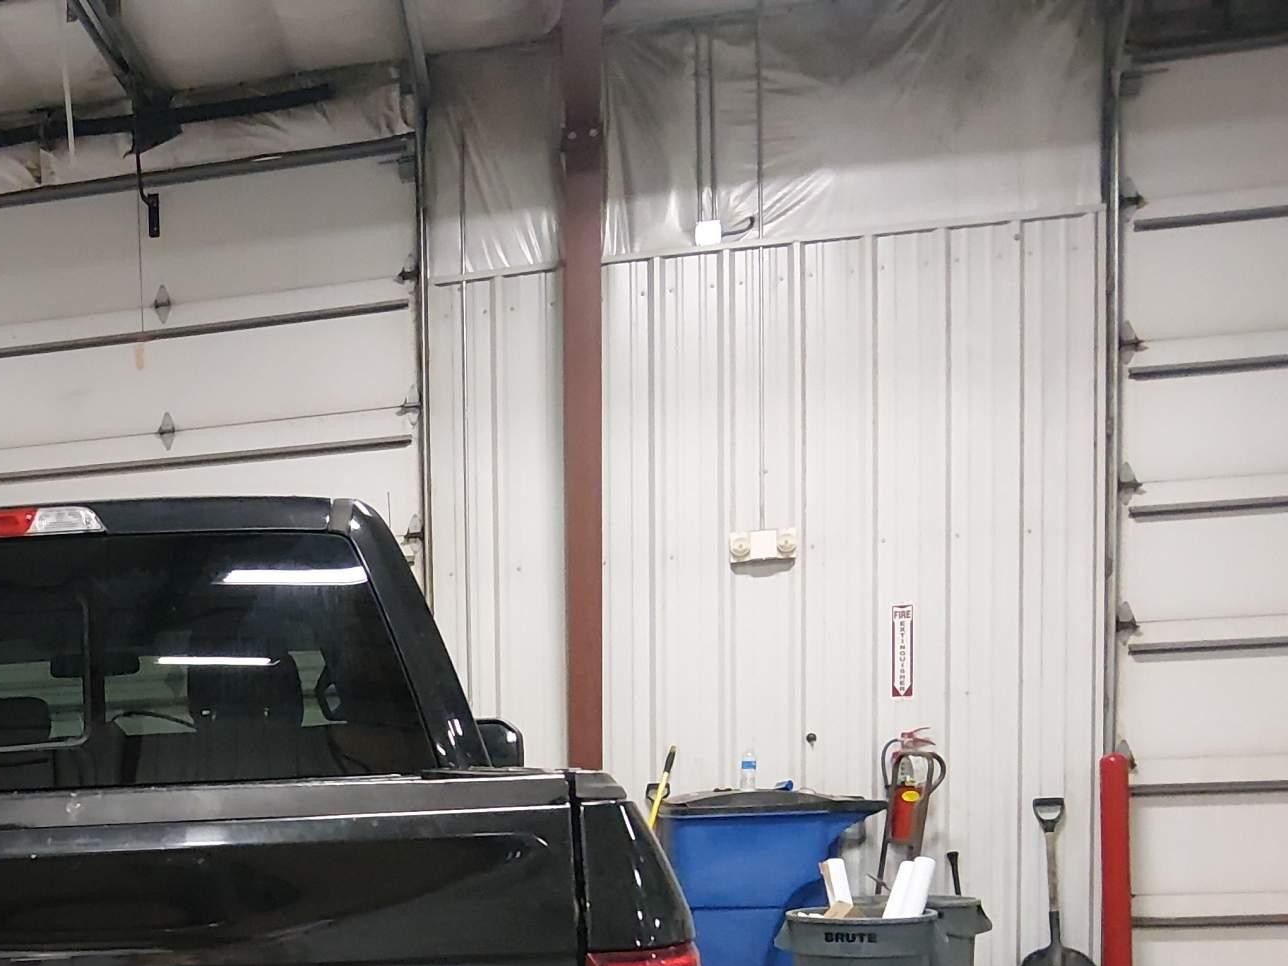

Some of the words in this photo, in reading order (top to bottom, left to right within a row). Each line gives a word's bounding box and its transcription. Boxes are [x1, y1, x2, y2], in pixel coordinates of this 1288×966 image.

[893, 610, 912, 620] FIRE
[898, 620, 907, 692] EXTINGUISHER
[824, 931, 878, 943] BRUTE
